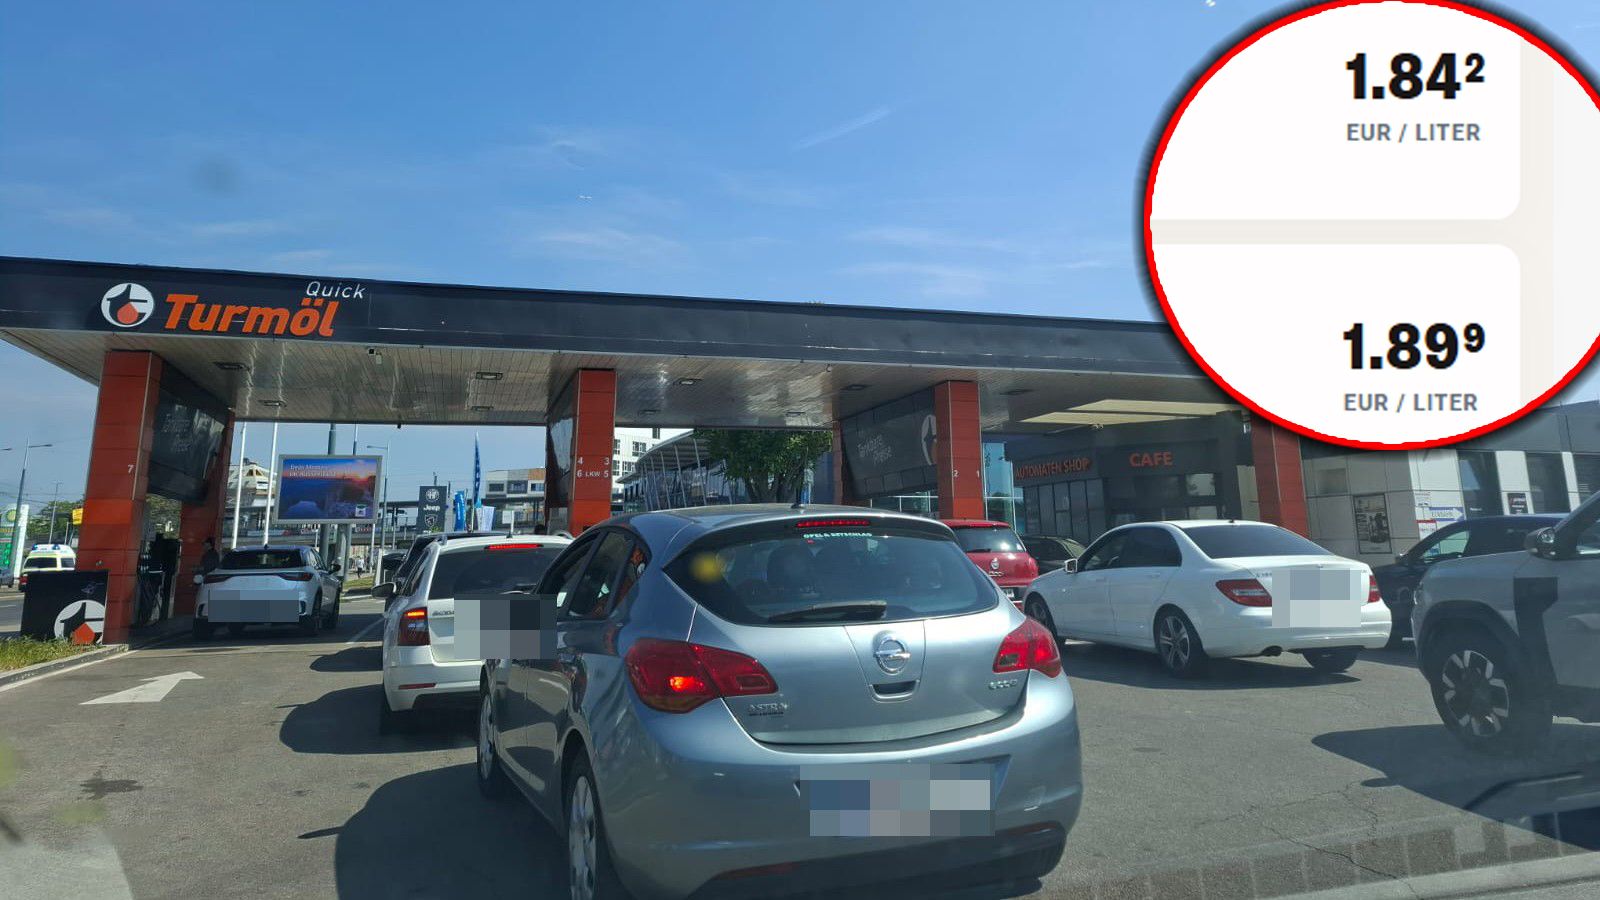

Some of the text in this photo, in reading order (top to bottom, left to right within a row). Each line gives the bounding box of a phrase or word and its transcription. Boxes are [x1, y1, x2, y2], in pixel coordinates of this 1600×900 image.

[305, 281, 366, 300] Quick
[164, 294, 340, 337] Turmöl
[577, 457, 584, 465] 4
[603, 457, 610, 465] 3
[1129, 451, 1174, 467] CAFE
[127, 464, 135, 474] 7
[1015, 457, 1091, 478] AUTOMATEN SHOP
[576, 469, 609, 478] 6 LKW 5
[952, 469, 959, 478] 2
[423, 504, 441, 512] Jeep
